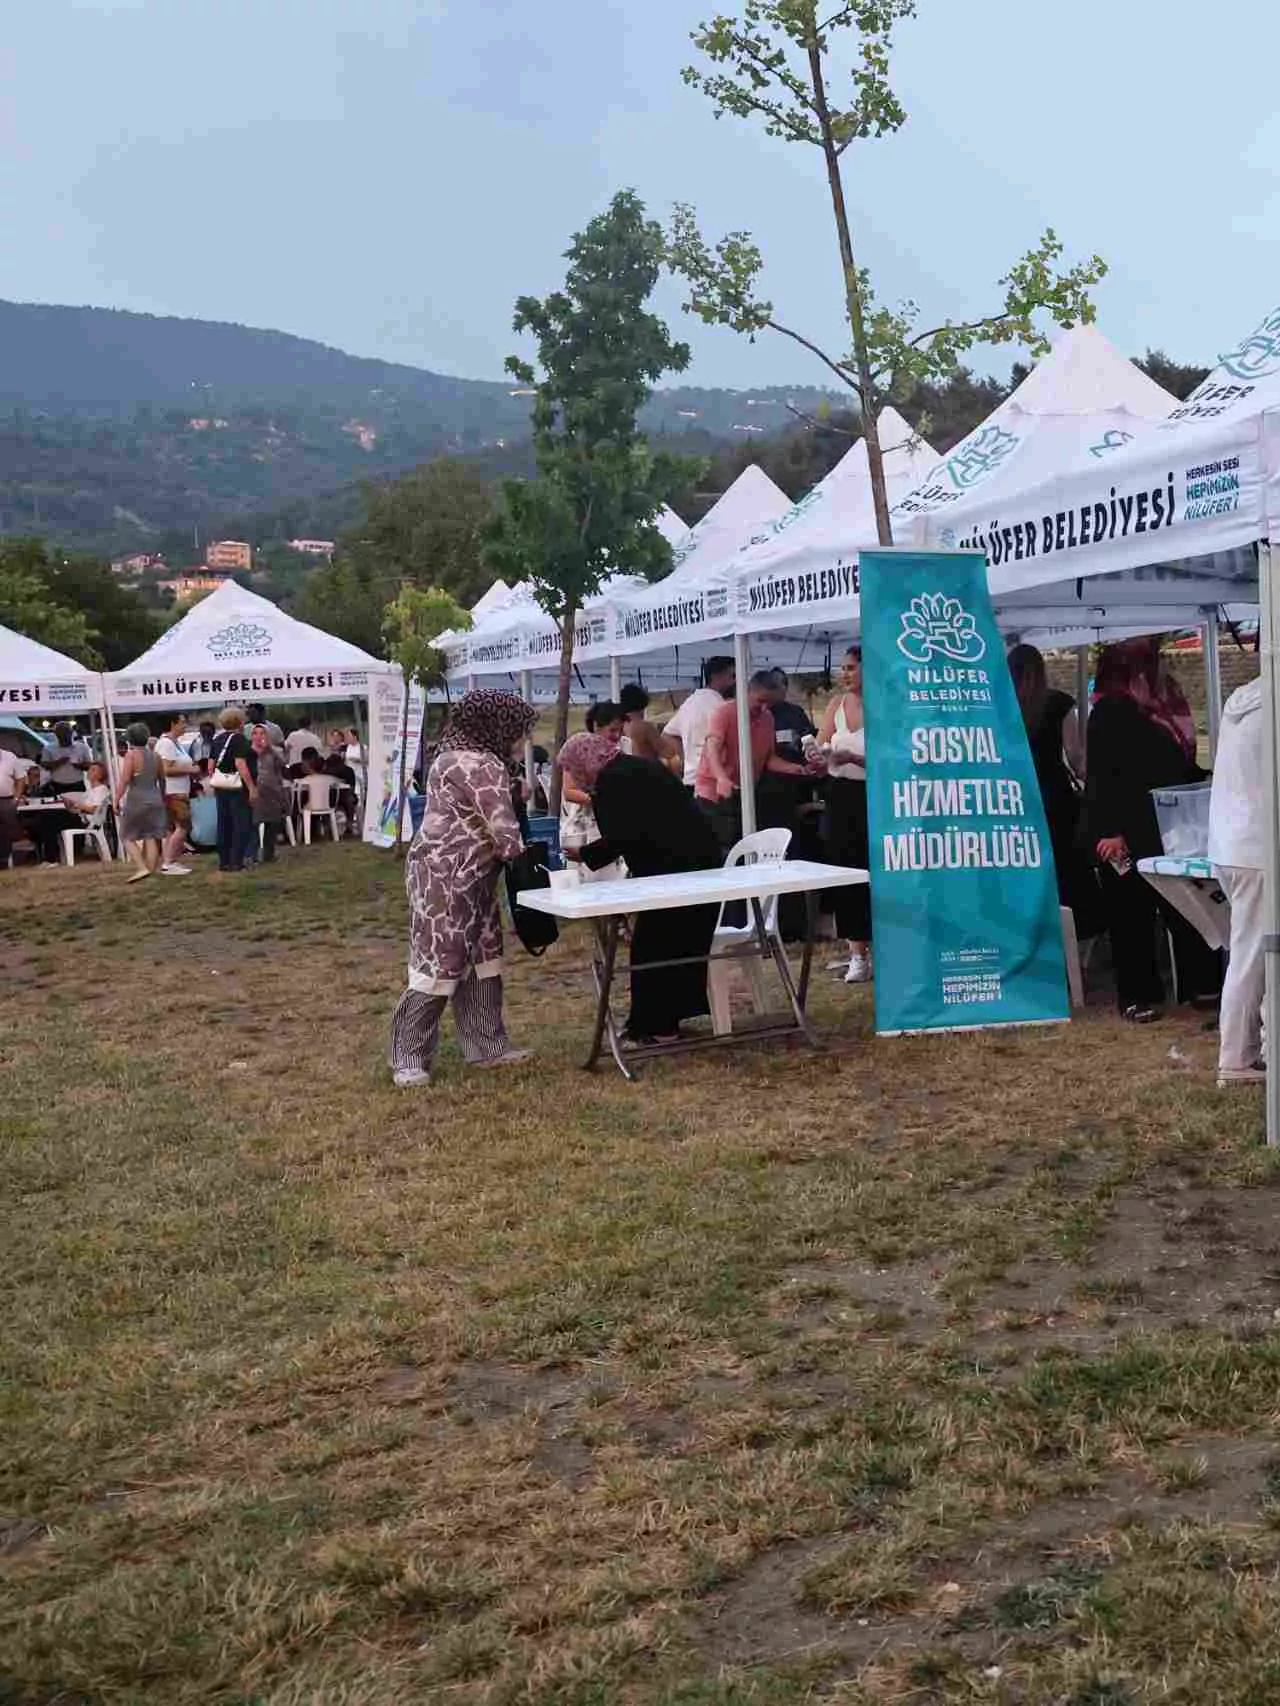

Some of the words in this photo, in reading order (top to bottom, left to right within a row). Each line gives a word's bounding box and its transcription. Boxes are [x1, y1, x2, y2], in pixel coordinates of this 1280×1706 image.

[960, 520, 1036, 567] LÜFER
[1042, 471, 1175, 554] BELEDİYESİ
[750, 574, 795, 611] NİLÜFER
[798, 559, 860, 602] BELEDİYE
[653, 591, 704, 632] BELEDİYESİ
[0, 685, 40, 702] YESİ
[143, 678, 222, 696] NİLÜFER
[229, 672, 333, 691] BELEDİYESİ
[908, 665, 990, 684] NİLÜFER
[910, 687, 992, 701] BELEDİYESİ
[911, 727, 1002, 764] SOSYAL
[893, 775, 1025, 820] HİZMETLER
[883, 825, 1041, 872] MÜDÜRLÜĞÜ
